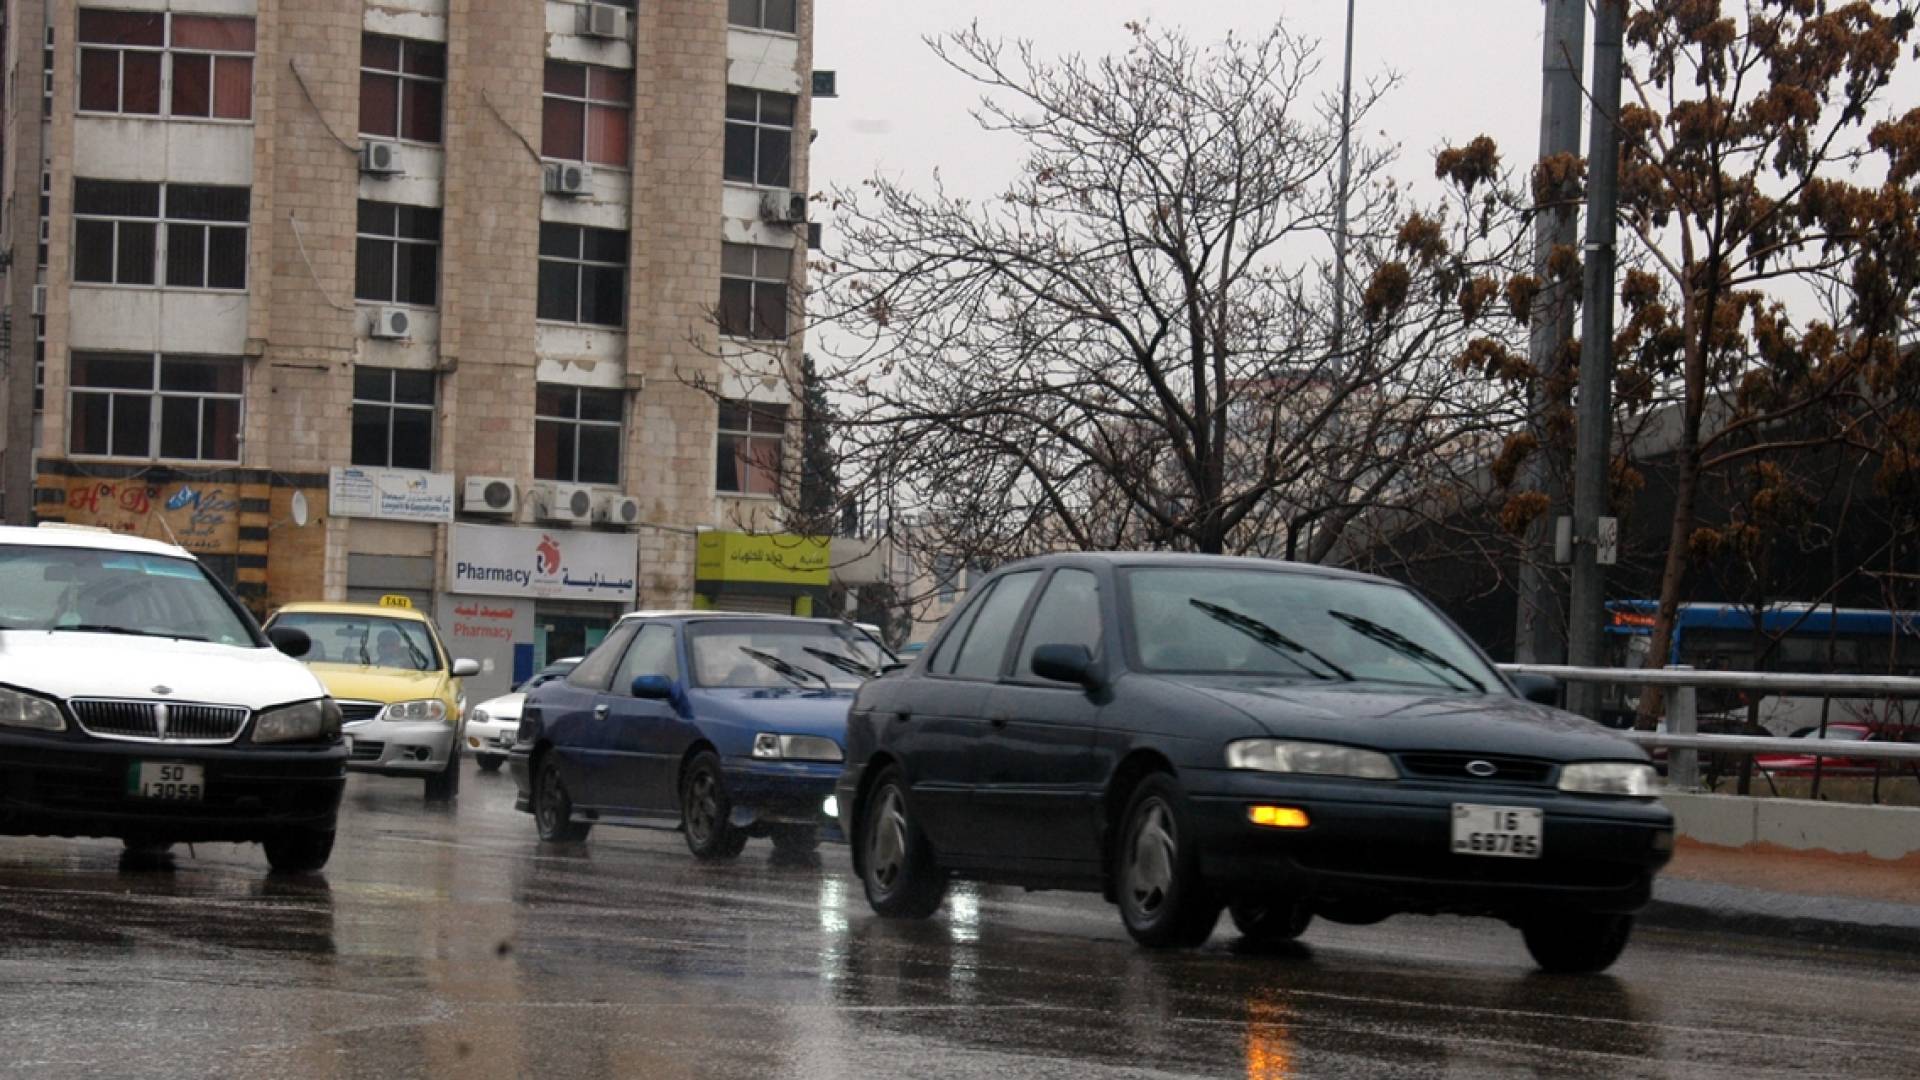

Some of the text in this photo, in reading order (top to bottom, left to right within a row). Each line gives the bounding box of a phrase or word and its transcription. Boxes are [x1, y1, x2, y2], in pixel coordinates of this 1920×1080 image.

[456, 561, 531, 587] Pharmacy
[562, 567, 633, 593] صيدلية
[386, 595, 408, 608] TAXI
[454, 622, 513, 641] Pharmacy
[160, 766, 185, 782] 50
[1493, 811, 1518, 831] 16
